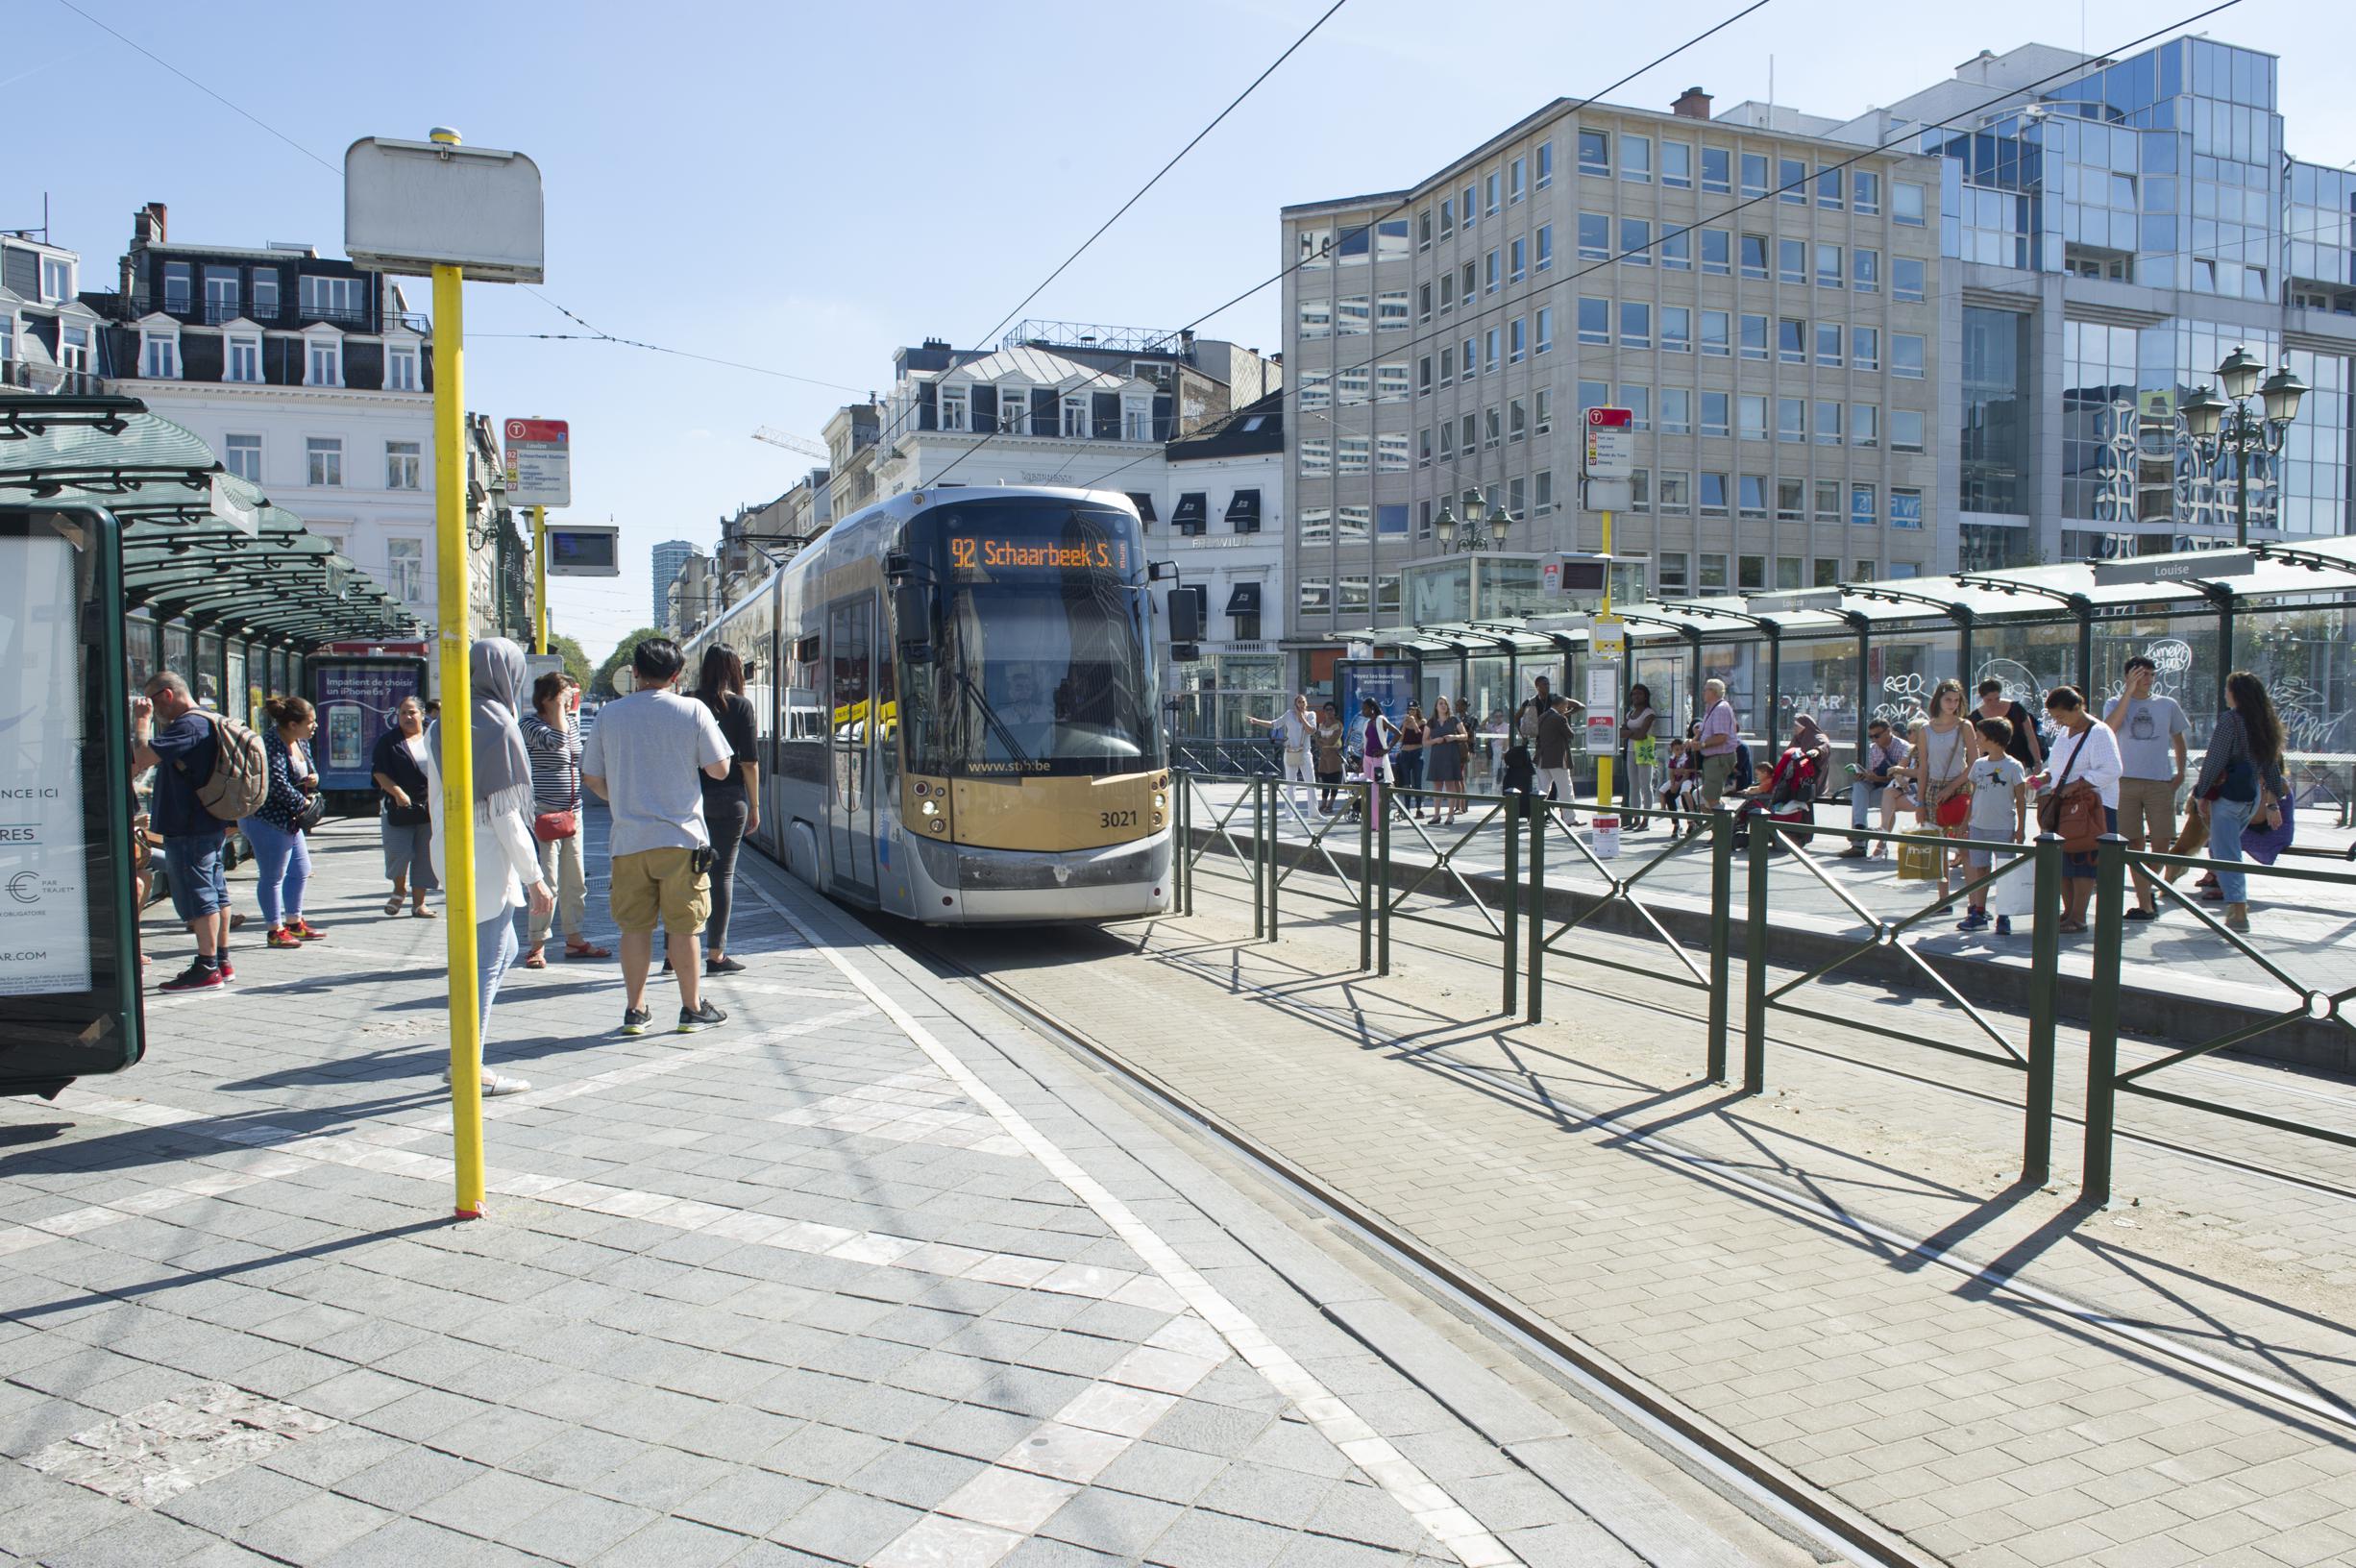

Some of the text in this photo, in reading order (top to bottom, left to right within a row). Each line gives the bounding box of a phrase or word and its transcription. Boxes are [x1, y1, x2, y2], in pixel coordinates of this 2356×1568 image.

[507, 451, 516, 459] 92
[507, 461, 517, 470] 93
[507, 482, 517, 491] 97
[952, 538, 976, 568] 92
[984, 541, 1092, 567] Schaarbeek
[2154, 565, 2190, 576] Louise
[327, 677, 413, 687] Impatient de choisir
[1, 788, 59, 798] NCE ICI
[1099, 810, 1138, 829] 3021
